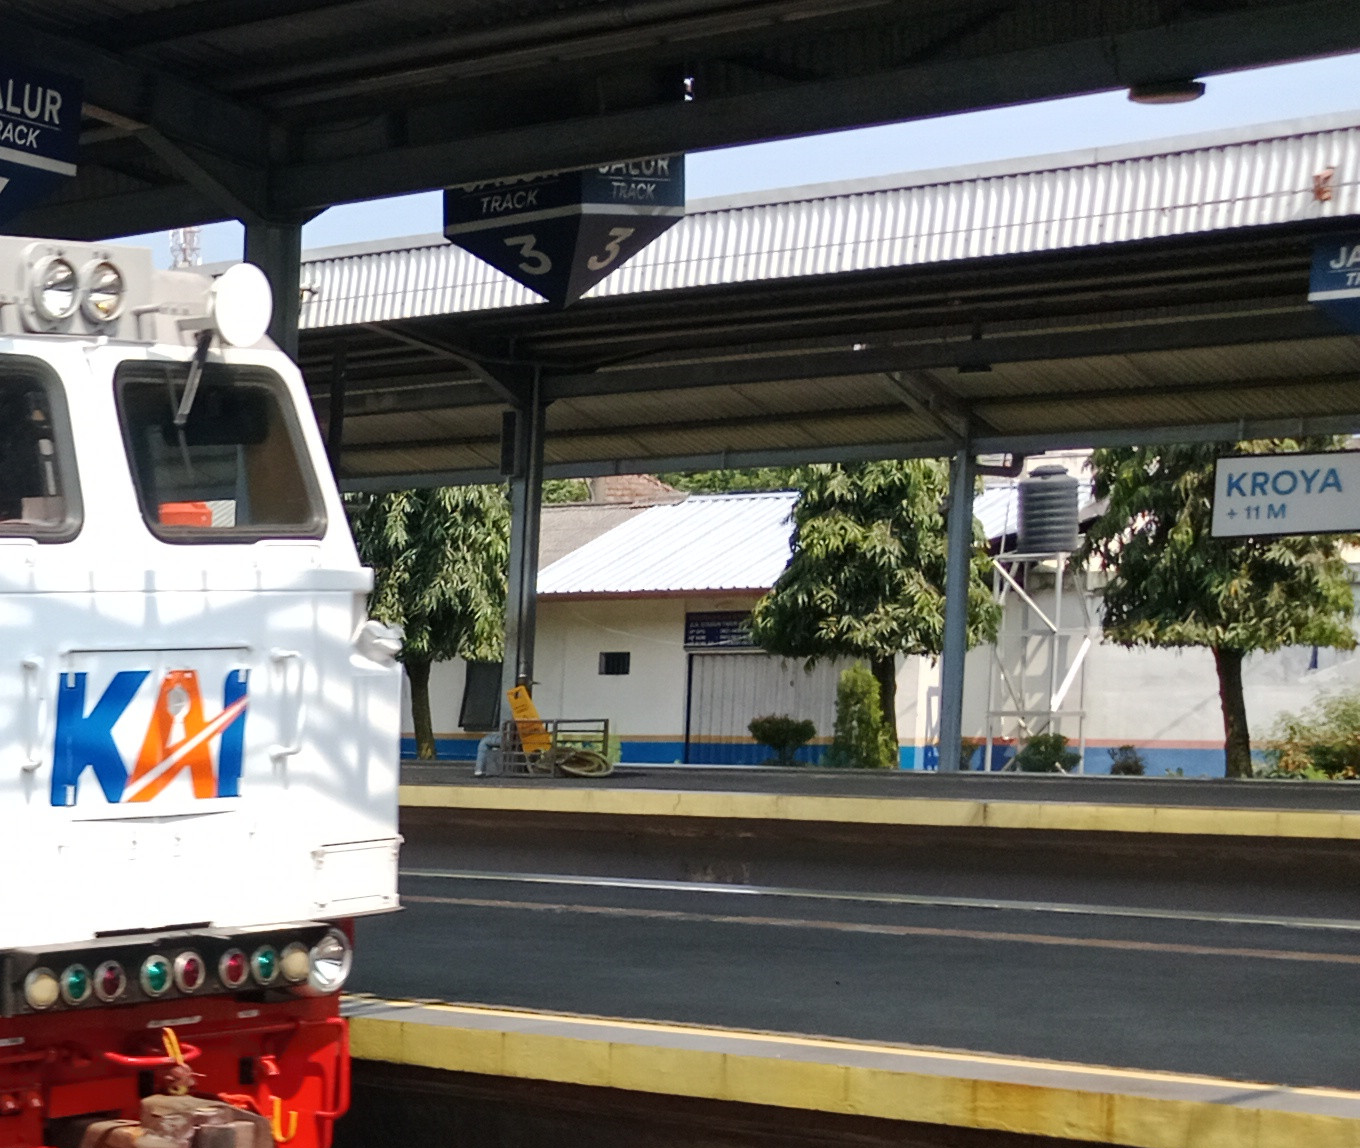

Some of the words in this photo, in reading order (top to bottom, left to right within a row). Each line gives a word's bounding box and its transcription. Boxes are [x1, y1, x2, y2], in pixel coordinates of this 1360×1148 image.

[480, 189, 539, 214] TRACK
[611, 180, 657, 201] TRACK
[502, 233, 553, 275] 3
[586, 227, 636, 272] 3
[1226, 467, 1343, 497] KROYA
[1245, 505, 1260, 520] 11
[1267, 503, 1287, 520] M
[50, 668, 252, 807] KAI
